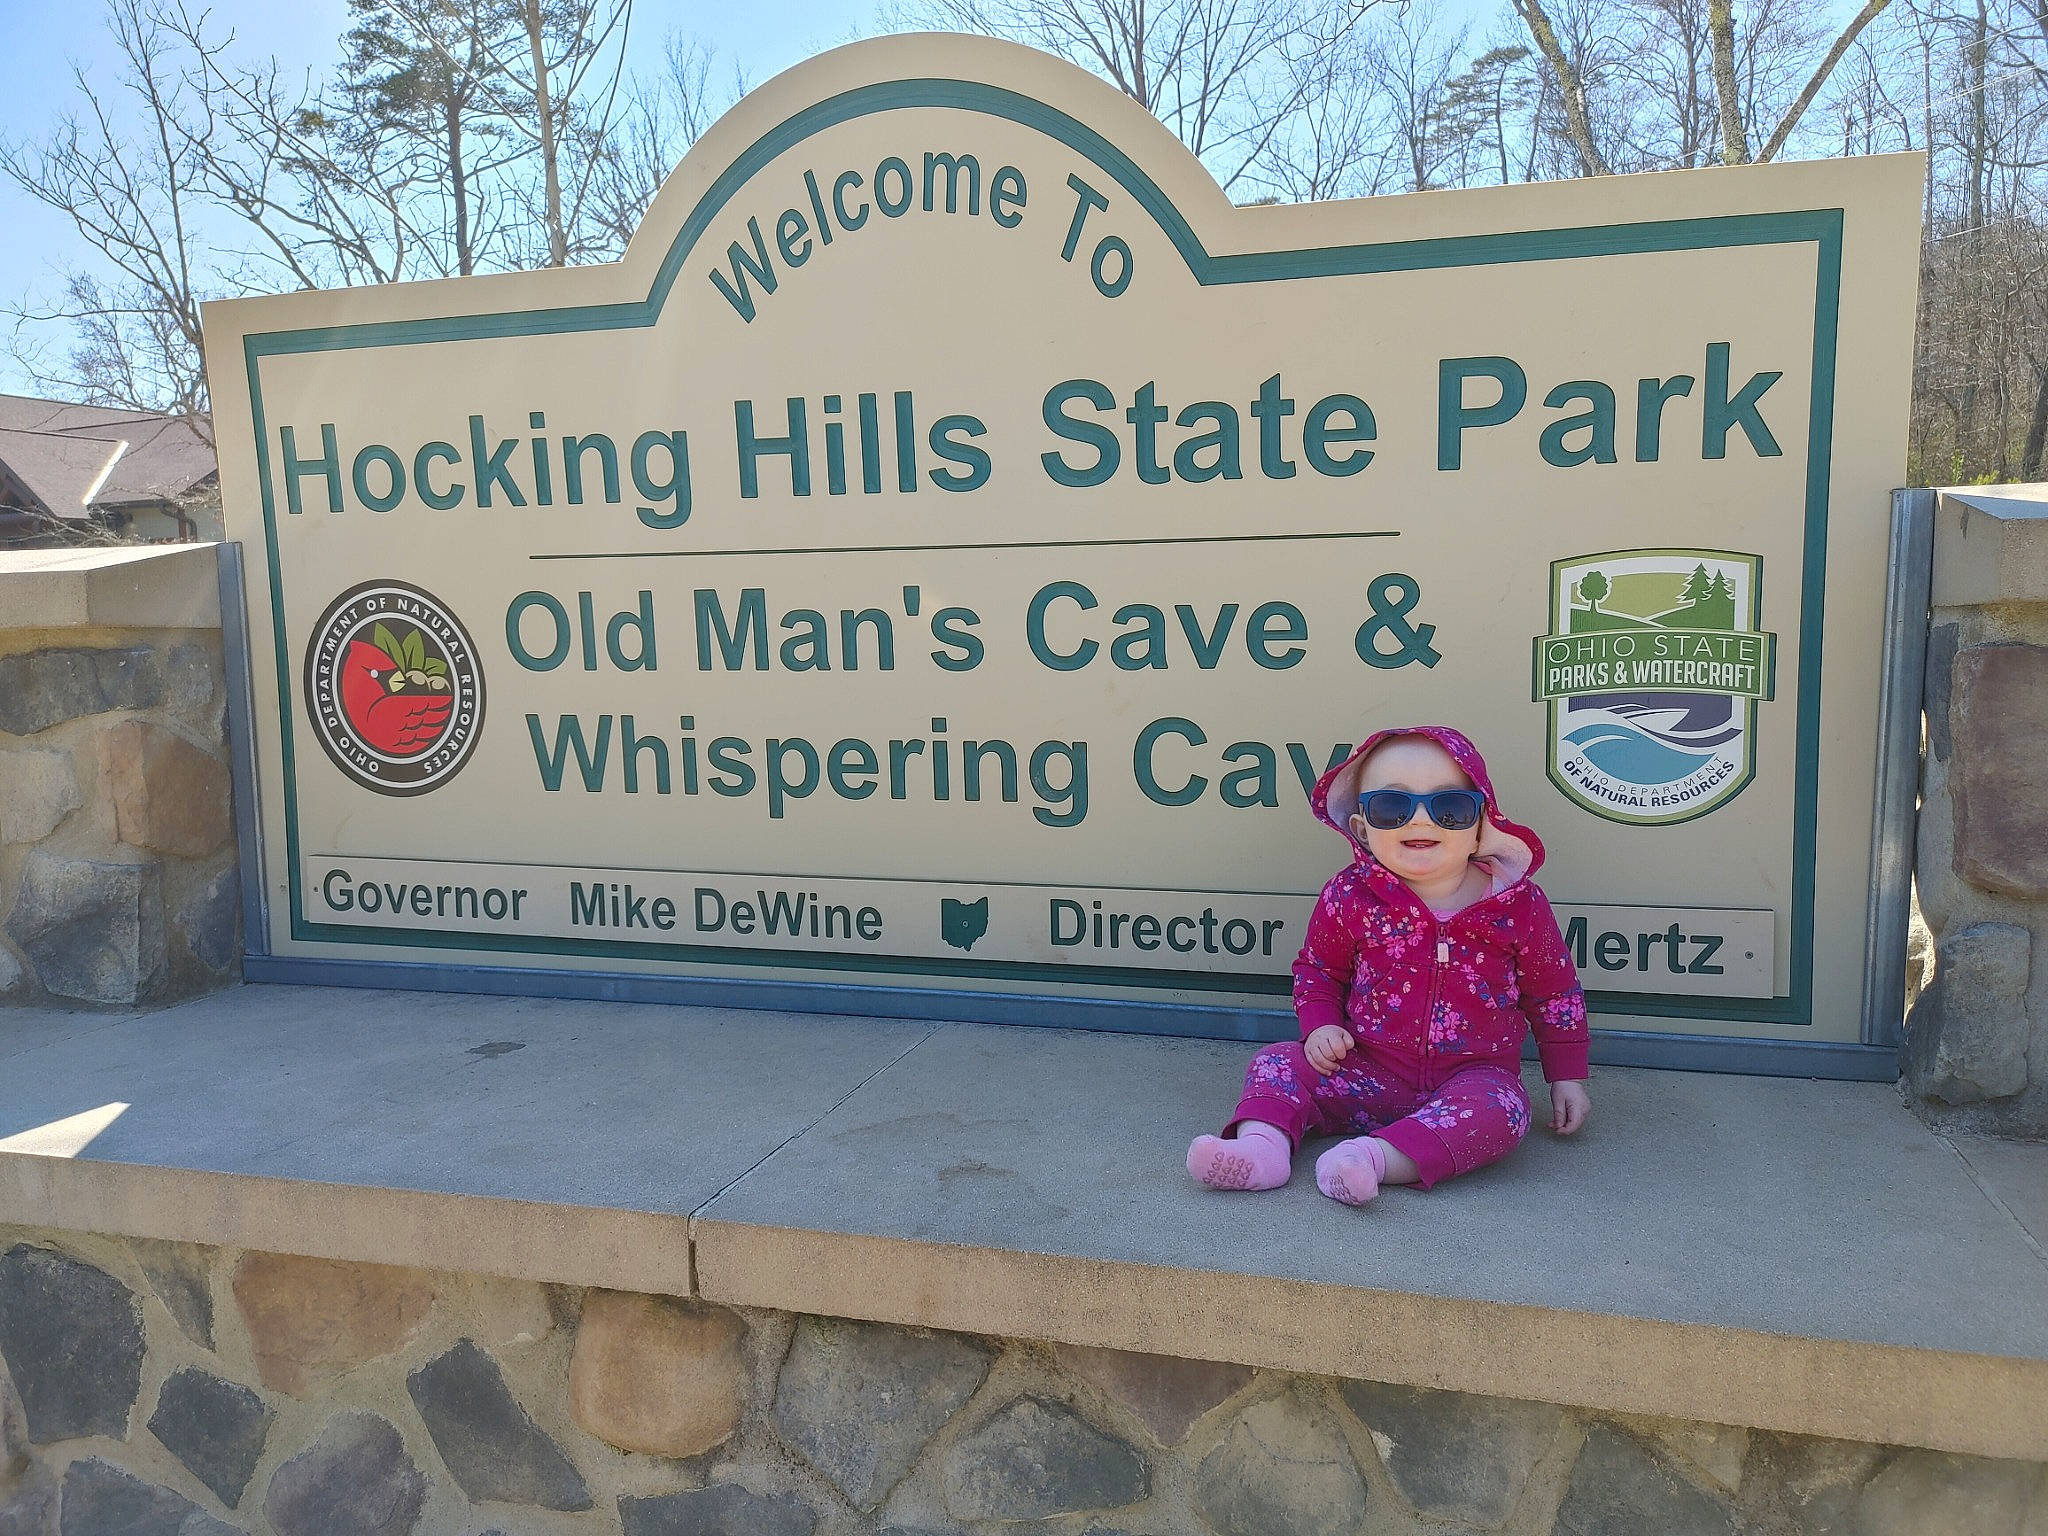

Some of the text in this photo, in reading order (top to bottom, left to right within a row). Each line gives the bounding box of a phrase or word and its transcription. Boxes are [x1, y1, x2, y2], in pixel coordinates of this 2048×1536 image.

[709, 150, 1133, 323] Welcome To
[280, 342, 1783, 529] Hocking Hills State Park
[506, 573, 1442, 671] Old Man's Cave &
[1549, 635, 1755, 664] OHIO STATE
[319, 598, 472, 773] OHIO DEPARTMENT OF NATURAL RESOURCES
[1550, 659, 1755, 691] PARKS & WATERCRAFT
[526, 712, 1352, 827] Whispering Cav
[1563, 760, 1735, 807] OF NATURAL RESOURCES
[1576, 756, 1721, 795] OHIO DEPARTMENT
[324, 870, 882, 940] Governor Mike DeWine
[1050, 899, 1284, 955] Director
